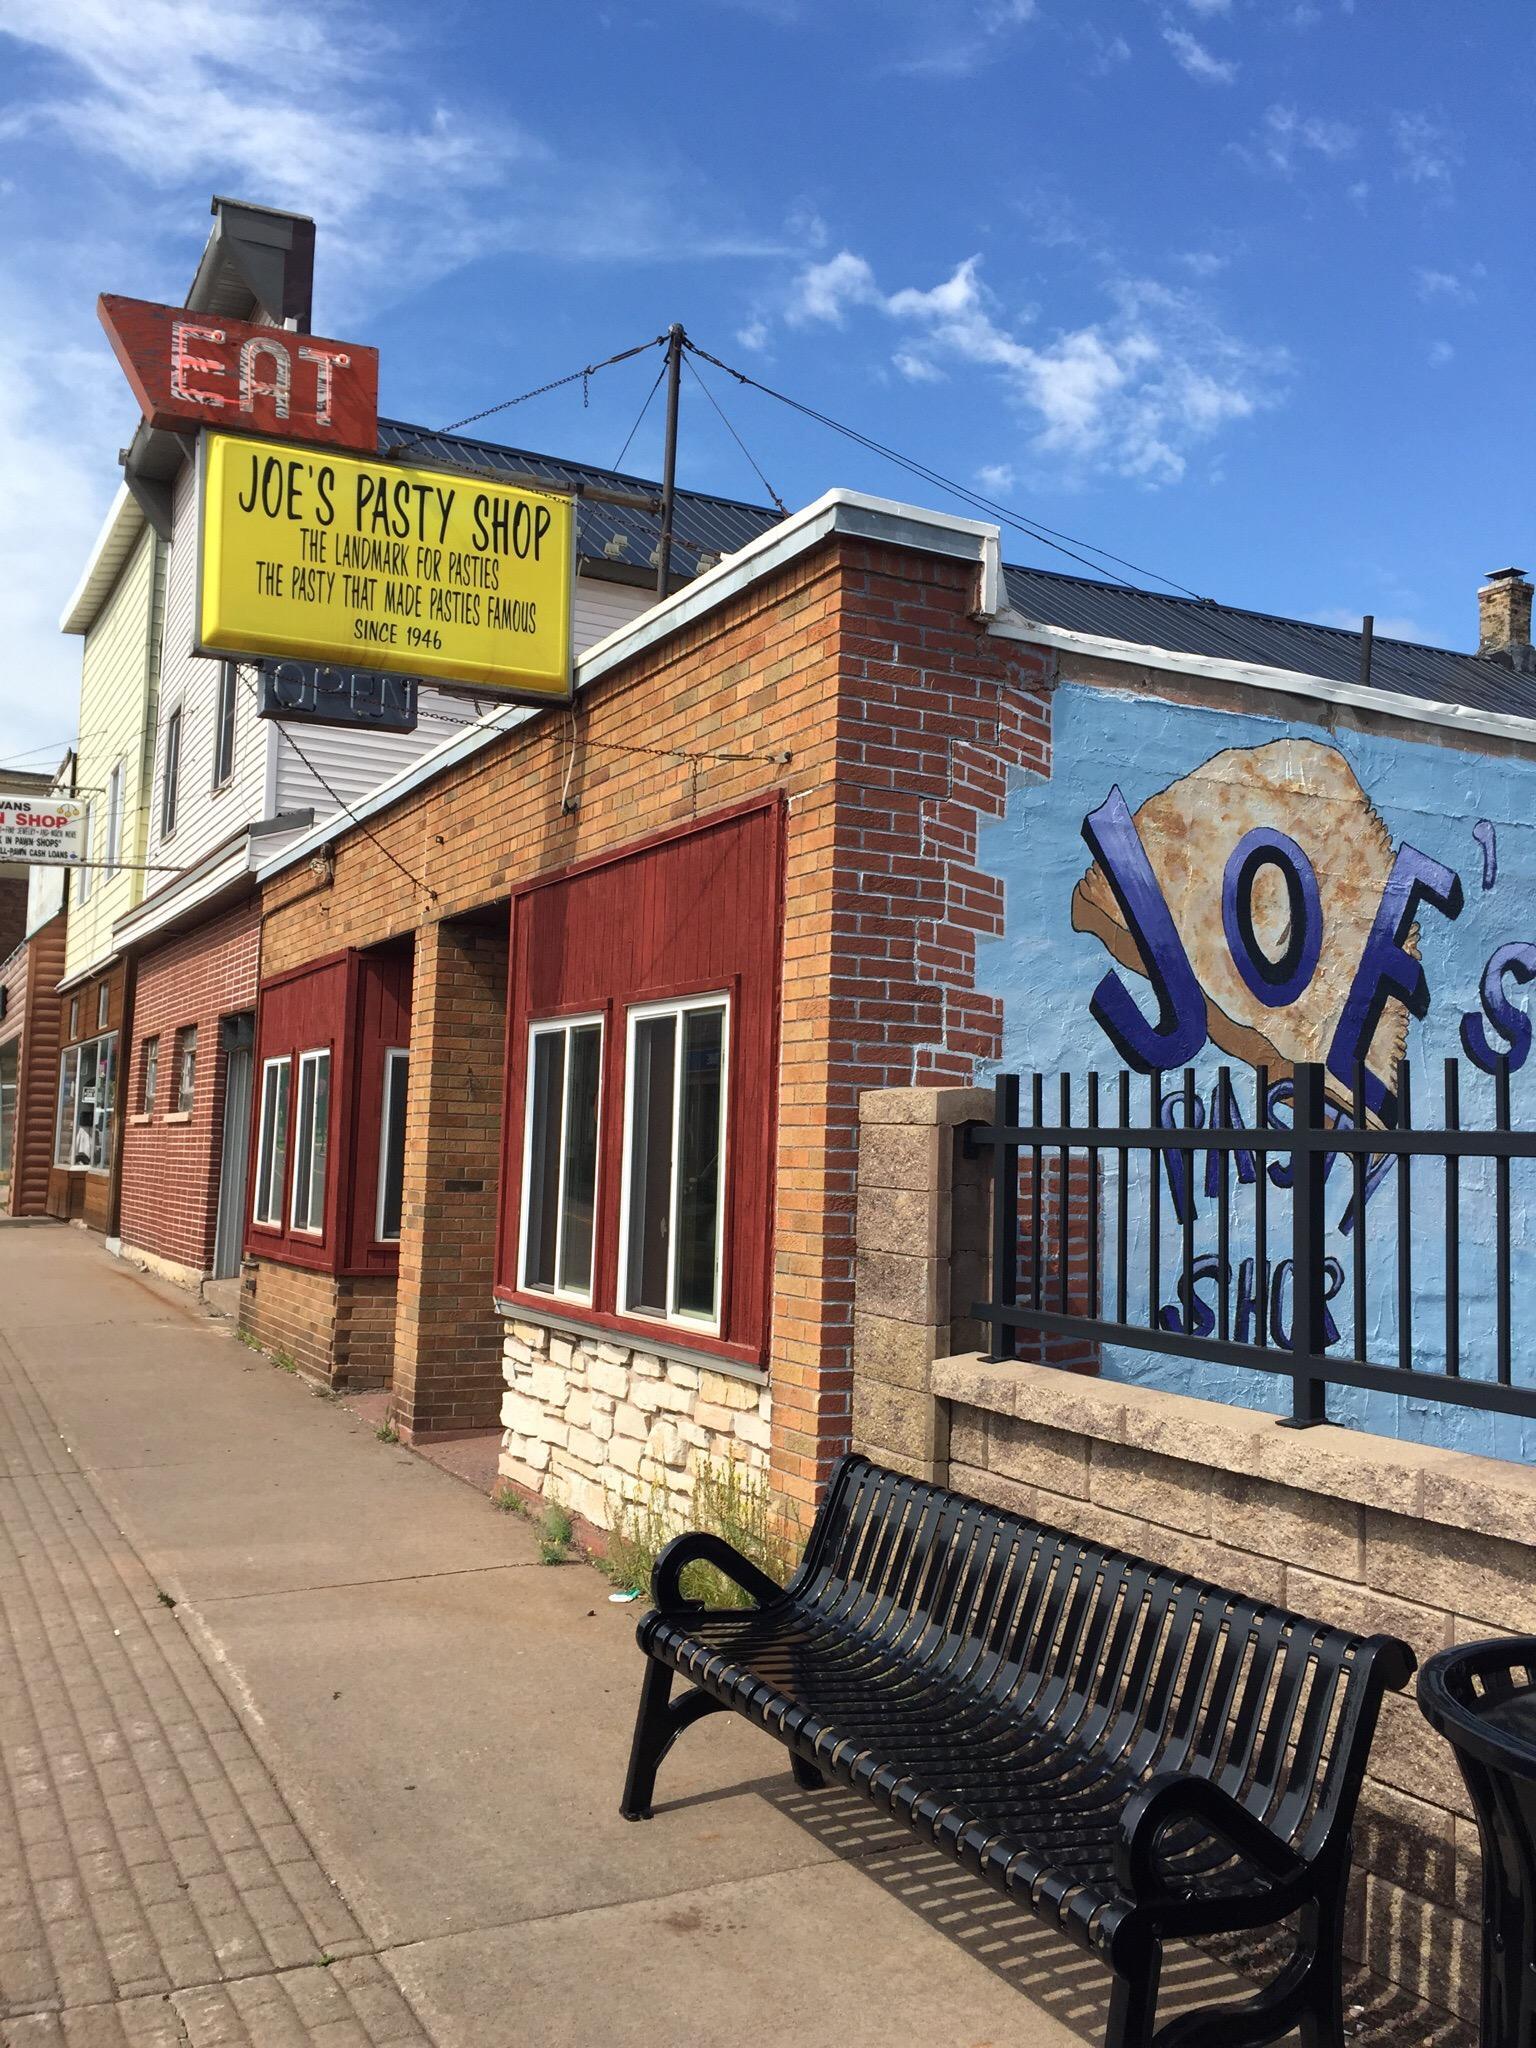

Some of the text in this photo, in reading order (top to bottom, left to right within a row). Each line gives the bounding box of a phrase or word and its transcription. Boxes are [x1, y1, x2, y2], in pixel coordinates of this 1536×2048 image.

[171, 320, 351, 426] EAT
[238, 454, 551, 561] JOE'S PASTY SHOP
[300, 528, 499, 591] THE LANDMARK FOR PASTIES
[256, 561, 536, 634] THE PASTY THAT MADE PASTIES FAMOUS
[354, 618, 442, 649] SINCE 1946
[273, 661, 411, 720] OPEN
[5, 836, 12, 844] IN
[15, 837, 34, 846] PAWN
[16, 813, 68, 829] SHOP
[29, 848, 46, 857] CASH
[48, 850, 68, 859] LOANS
